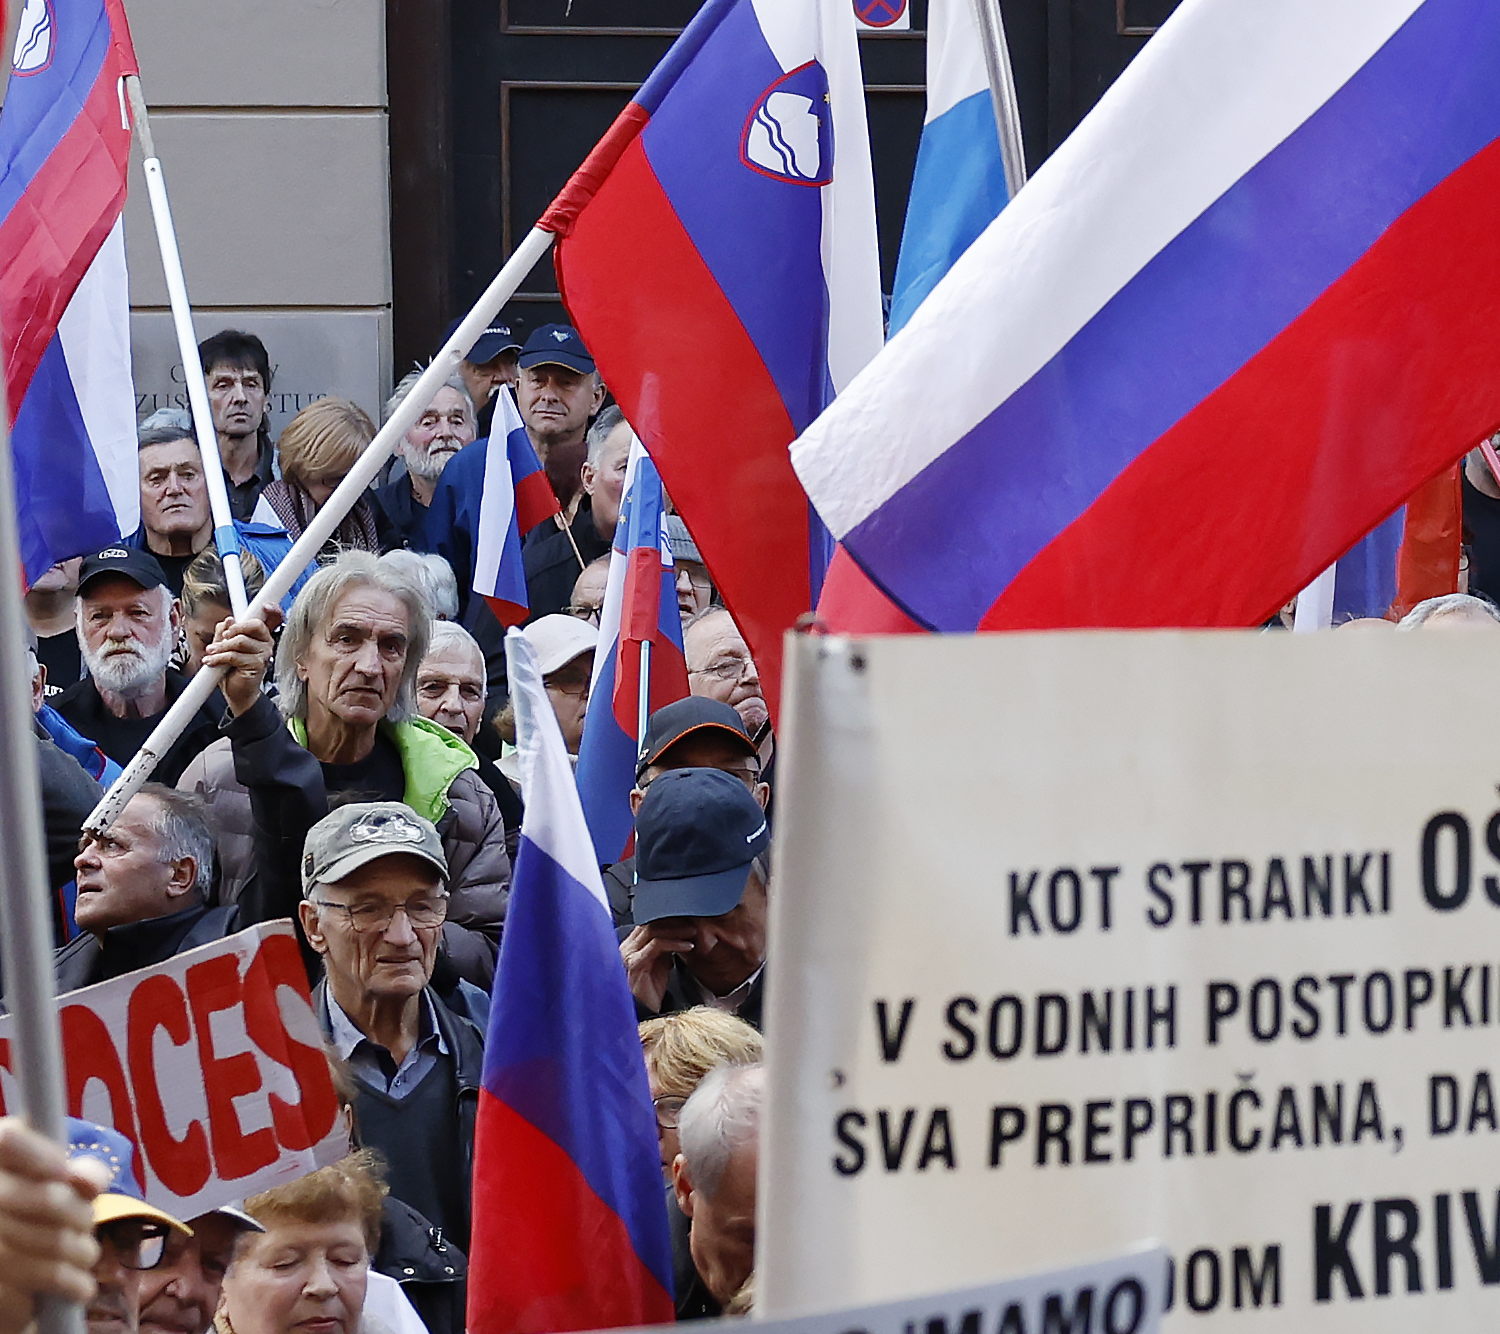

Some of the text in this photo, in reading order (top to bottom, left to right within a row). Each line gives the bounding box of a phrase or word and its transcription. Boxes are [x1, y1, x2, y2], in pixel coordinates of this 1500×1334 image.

[1007, 864, 1122, 938] KOT
[1146, 851, 1394, 931] STRANKI
[873, 997, 914, 1064] V
[941, 985, 1178, 1063] SODNIH
[832, 1106, 956, 1178] SVA
[988, 1070, 1404, 1172] PREPRIČANA,
[1427, 1071, 1499, 1139] DA
[1162, 1245, 1281, 1315] OM
